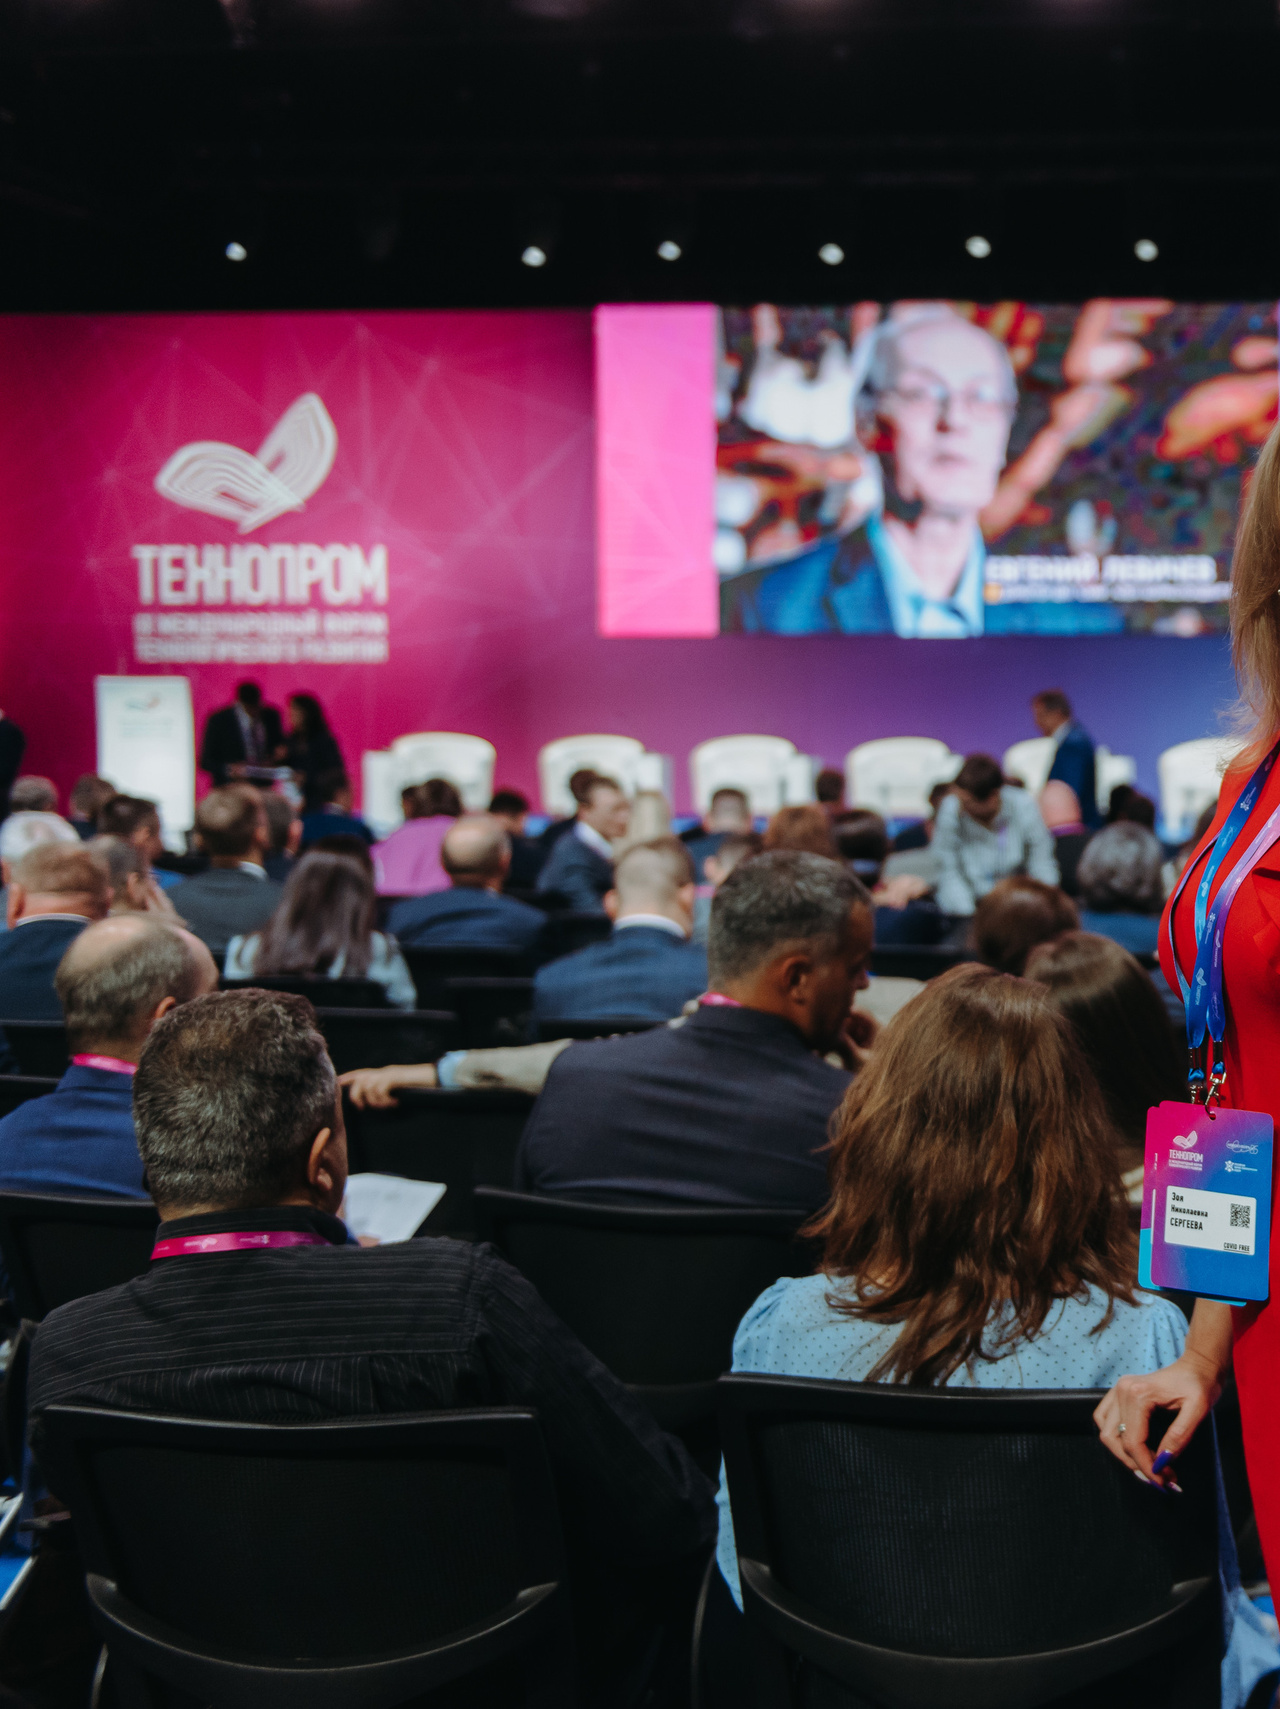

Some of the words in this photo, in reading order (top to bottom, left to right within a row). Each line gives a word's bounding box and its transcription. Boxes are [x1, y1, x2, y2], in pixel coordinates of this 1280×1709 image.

[132, 543, 387, 604] ТЕХНОПРОМ
[1172, 1192, 1184, 1202] Зоя
[1171, 1204, 1208, 1217] Николаевна
[1170, 1217, 1203, 1230] СЕРГЕЕВА
[1224, 1242, 1237, 1250] COVID
